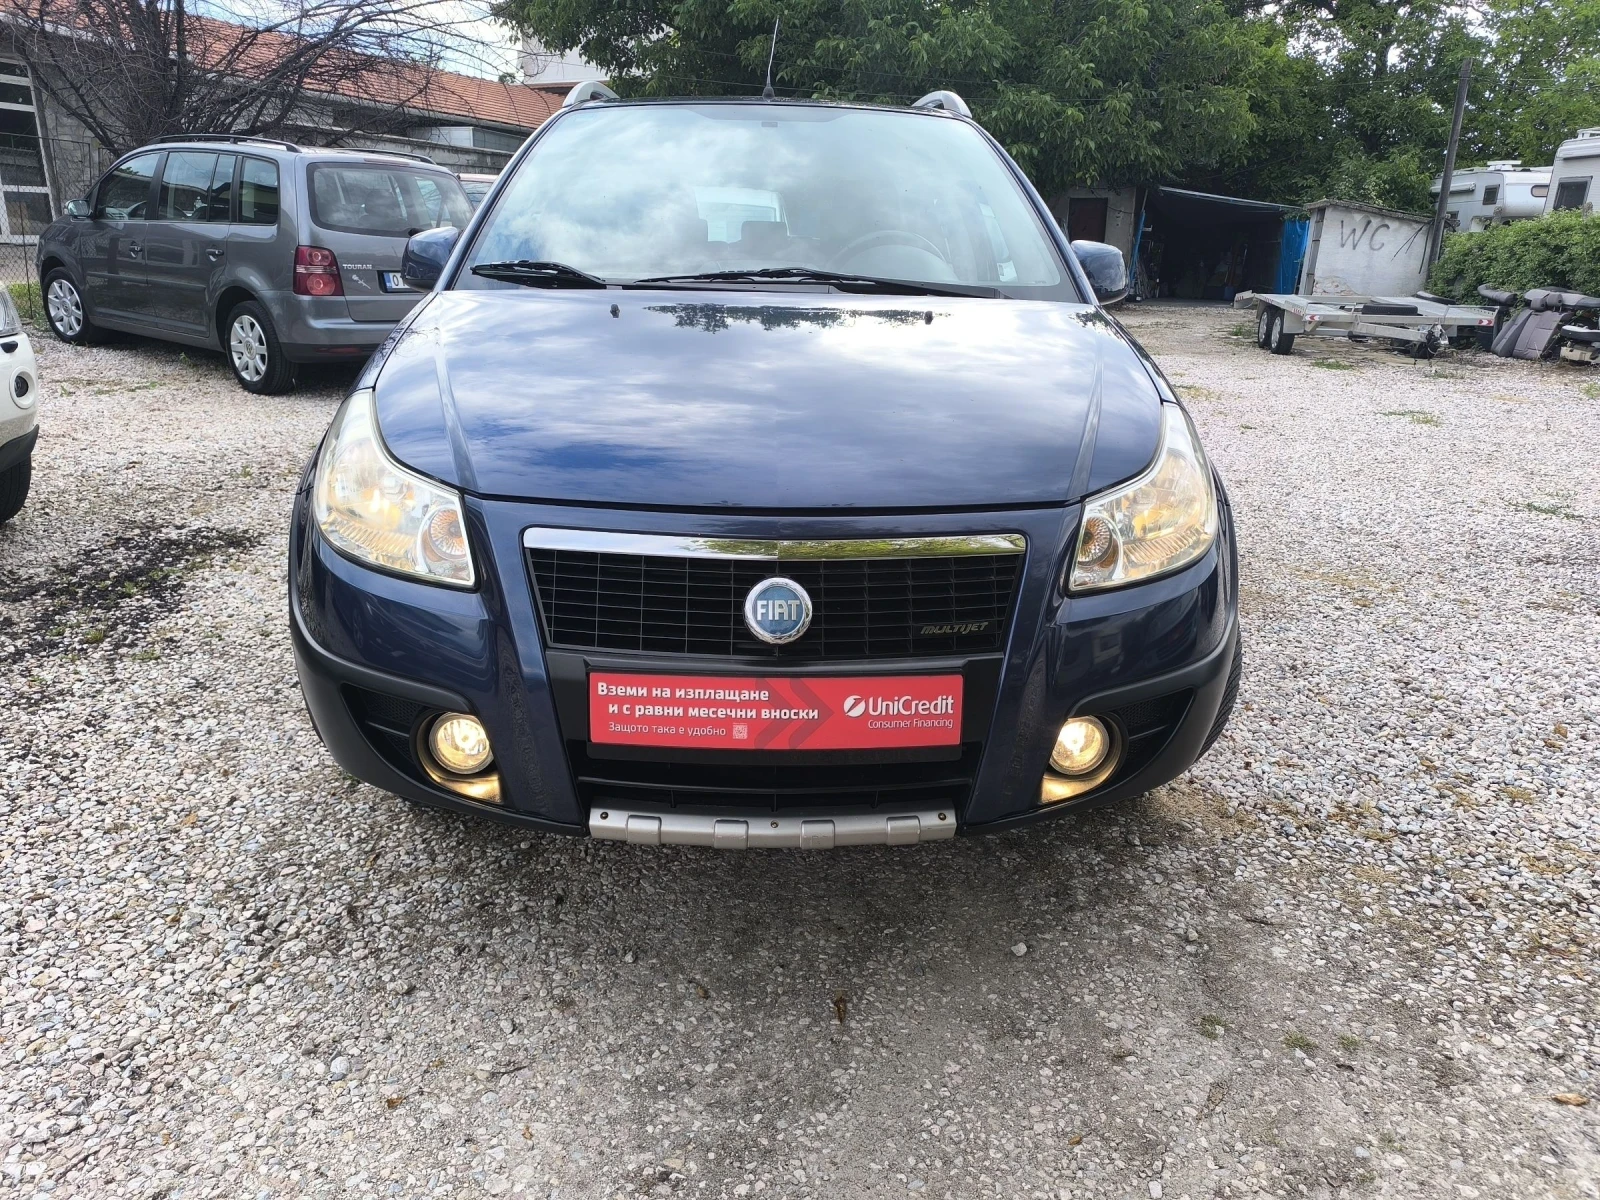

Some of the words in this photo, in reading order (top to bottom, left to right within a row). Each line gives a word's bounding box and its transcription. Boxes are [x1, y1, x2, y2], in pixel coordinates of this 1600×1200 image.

[1340, 219, 1390, 251] WC
[756, 600, 800, 621] FIAT
[920, 621, 989, 634] MULTIJET
[597, 682, 648, 698] Вземи
[652, 687, 671, 698] на
[675, 687, 770, 703] изплащане
[608, 703, 619, 714] и
[622, 704, 631, 715] с
[635, 704, 684, 718] равни
[688, 707, 757, 719] месечни
[761, 708, 819, 720] вноски
[868, 695, 954, 716] UniCredit
[608, 721, 649, 733] Защото
[652, 723, 676, 734] така
[679, 726, 685, 735] е
[687, 723, 726, 737] удобно
[868, 718, 912, 729] Consumer
[913, 718, 953, 729] Financing
